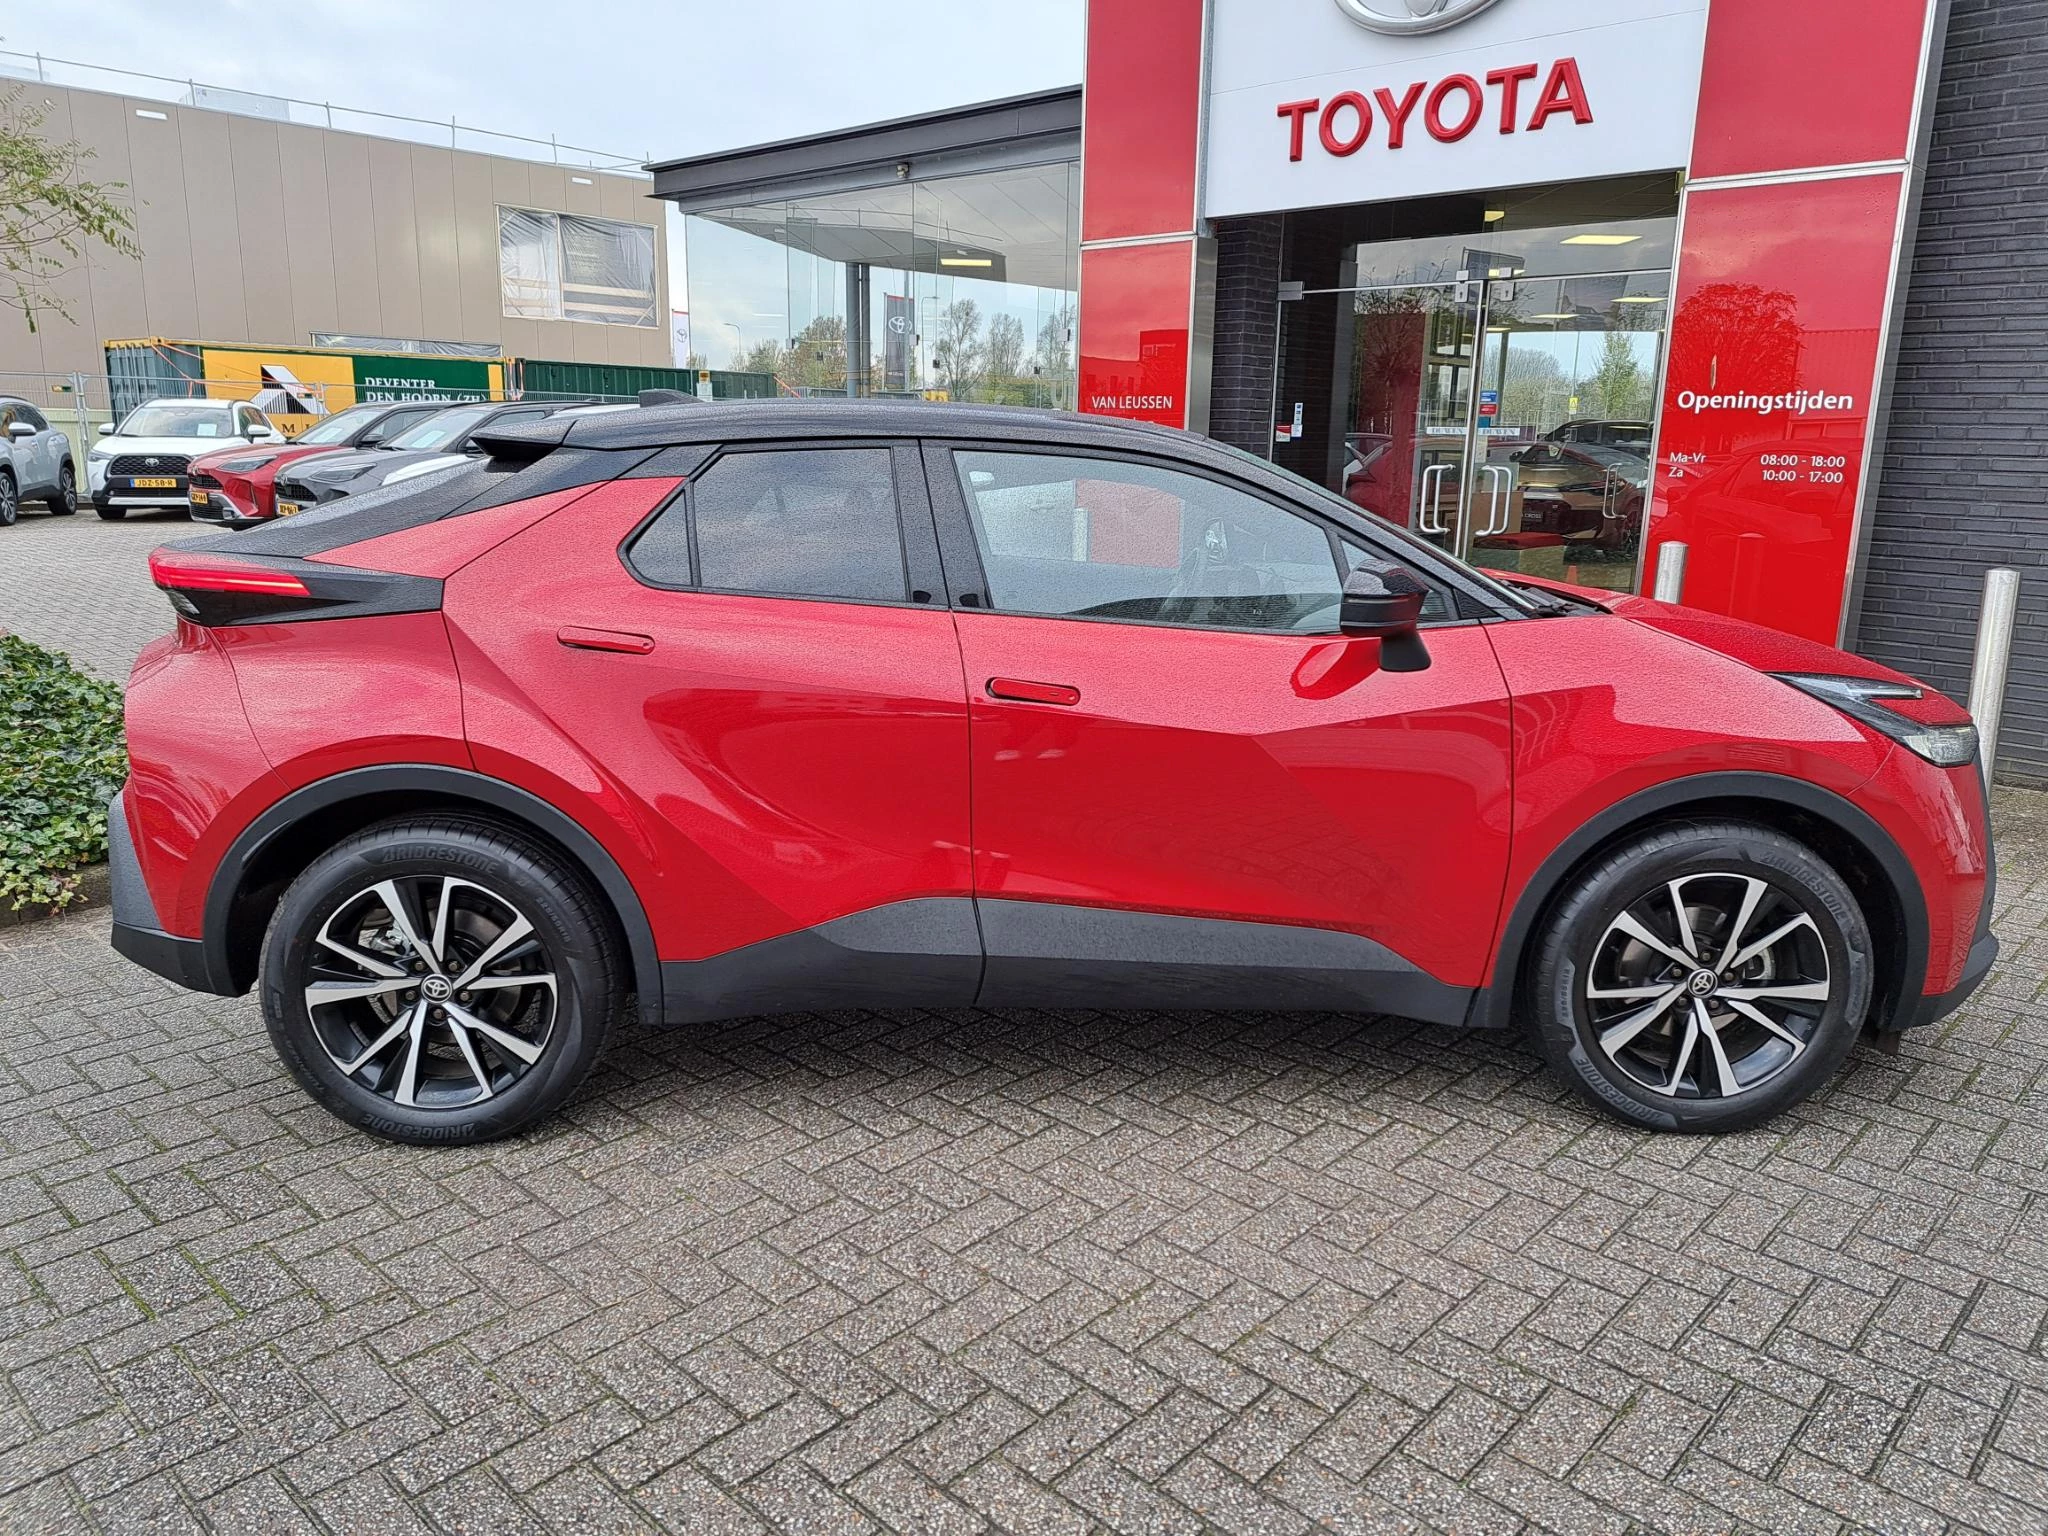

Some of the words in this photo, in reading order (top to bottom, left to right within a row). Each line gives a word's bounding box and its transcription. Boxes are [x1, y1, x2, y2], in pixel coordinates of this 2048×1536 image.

[1277, 57, 1593, 162] TOYOTA
[365, 377, 436, 389] DEVENTER
[366, 391, 395, 402] DEN
[401, 392, 451, 402] HOORN
[457, 393, 486, 402] (ZH)
[1092, 395, 1116, 409] VAN
[1119, 395, 1173, 409] LEUSSEN
[1677, 390, 1853, 415] Openingstijden
[1669, 452, 1707, 464] Ma-Vr
[1760, 454, 1798, 467] 08:00
[1811, 455, 1845, 468] 18:00
[1668, 466, 1684, 478] Za
[1762, 469, 1797, 482] 10:00
[1809, 471, 1843, 484] 17:00
[382, 844, 499, 874] BRIDGESTONE
[1575, 1056, 1663, 1124] BRIDGESTONE
[362, 1112, 476, 1140] BRIDGESTONE
